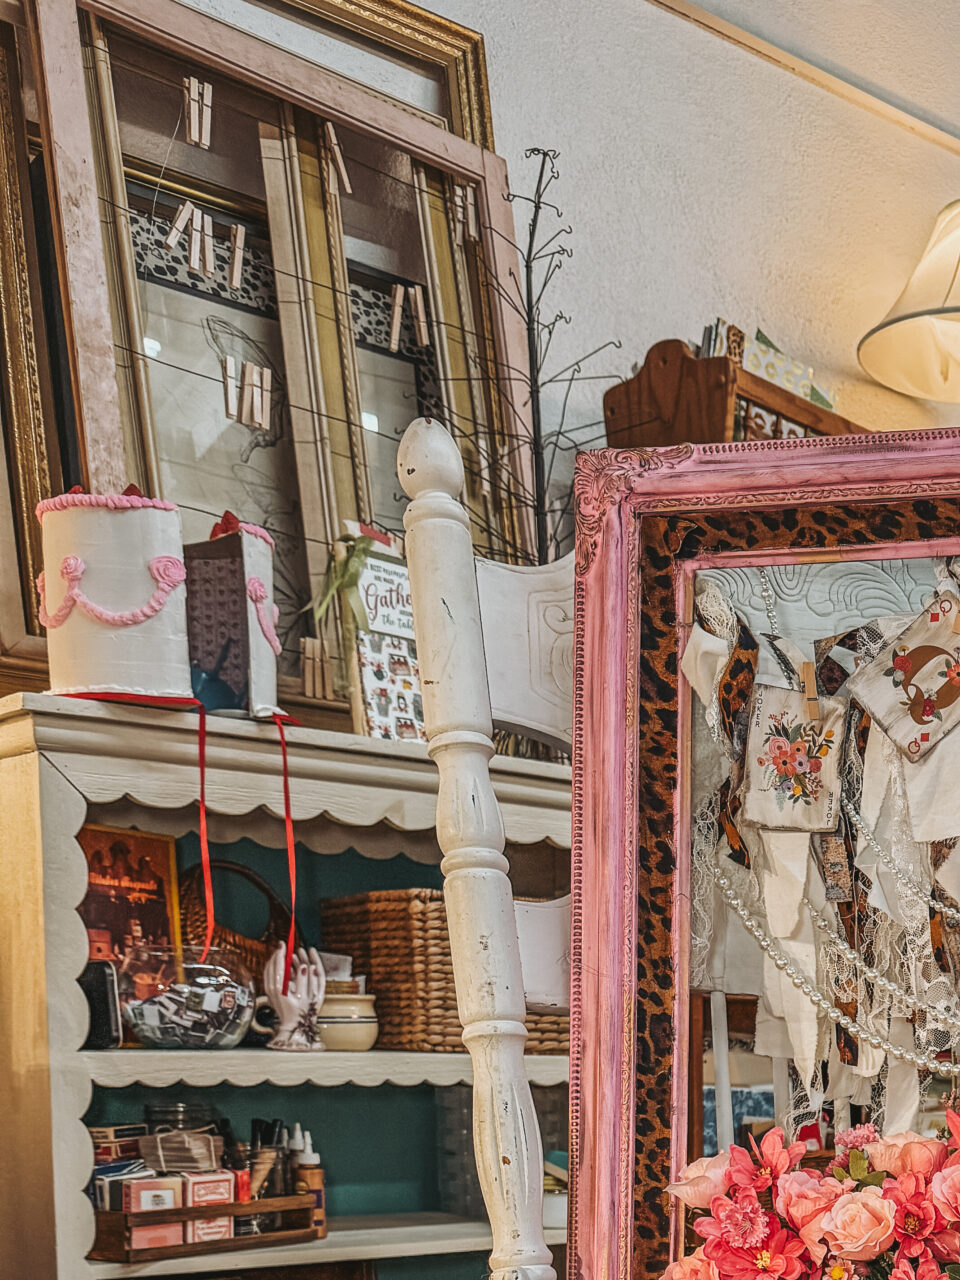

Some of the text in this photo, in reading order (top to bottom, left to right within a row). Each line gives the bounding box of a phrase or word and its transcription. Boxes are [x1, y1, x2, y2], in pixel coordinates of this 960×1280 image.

[361, 582, 412, 626] Gathe
[939, 599, 953, 617] Q
[754, 690, 763, 728] JOKER
[907, 737, 921, 755] Q
[826, 791, 834, 826] JOKER
